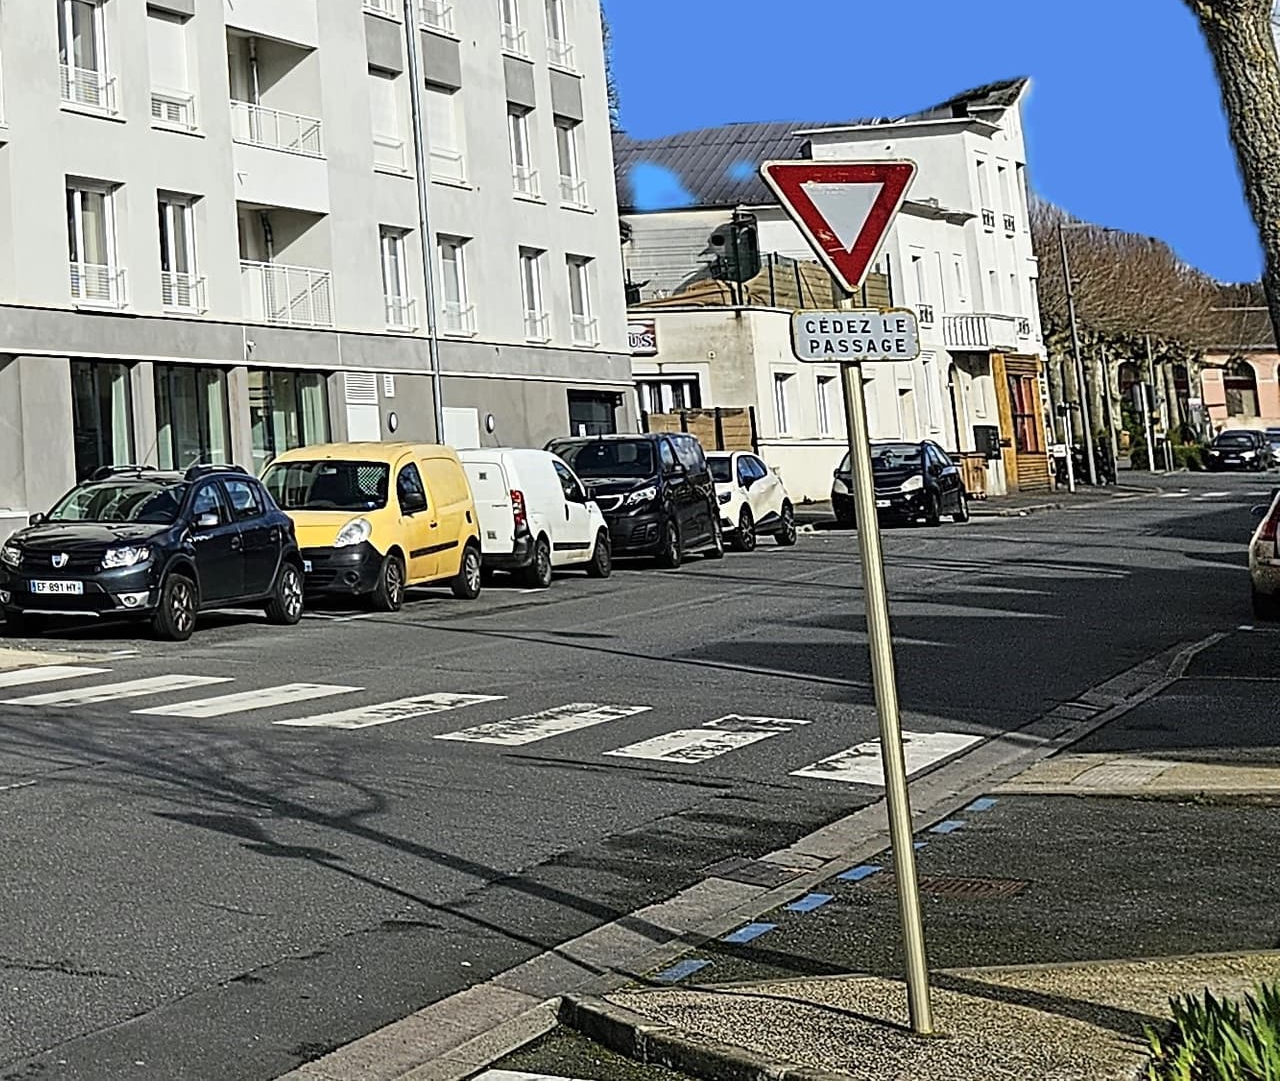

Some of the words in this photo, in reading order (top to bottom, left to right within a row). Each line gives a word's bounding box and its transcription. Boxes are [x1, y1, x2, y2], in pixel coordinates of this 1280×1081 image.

[805, 317, 871, 334] CÉDEZ
[882, 319, 906, 333] LE
[809, 338, 907, 354] PASSAGE
